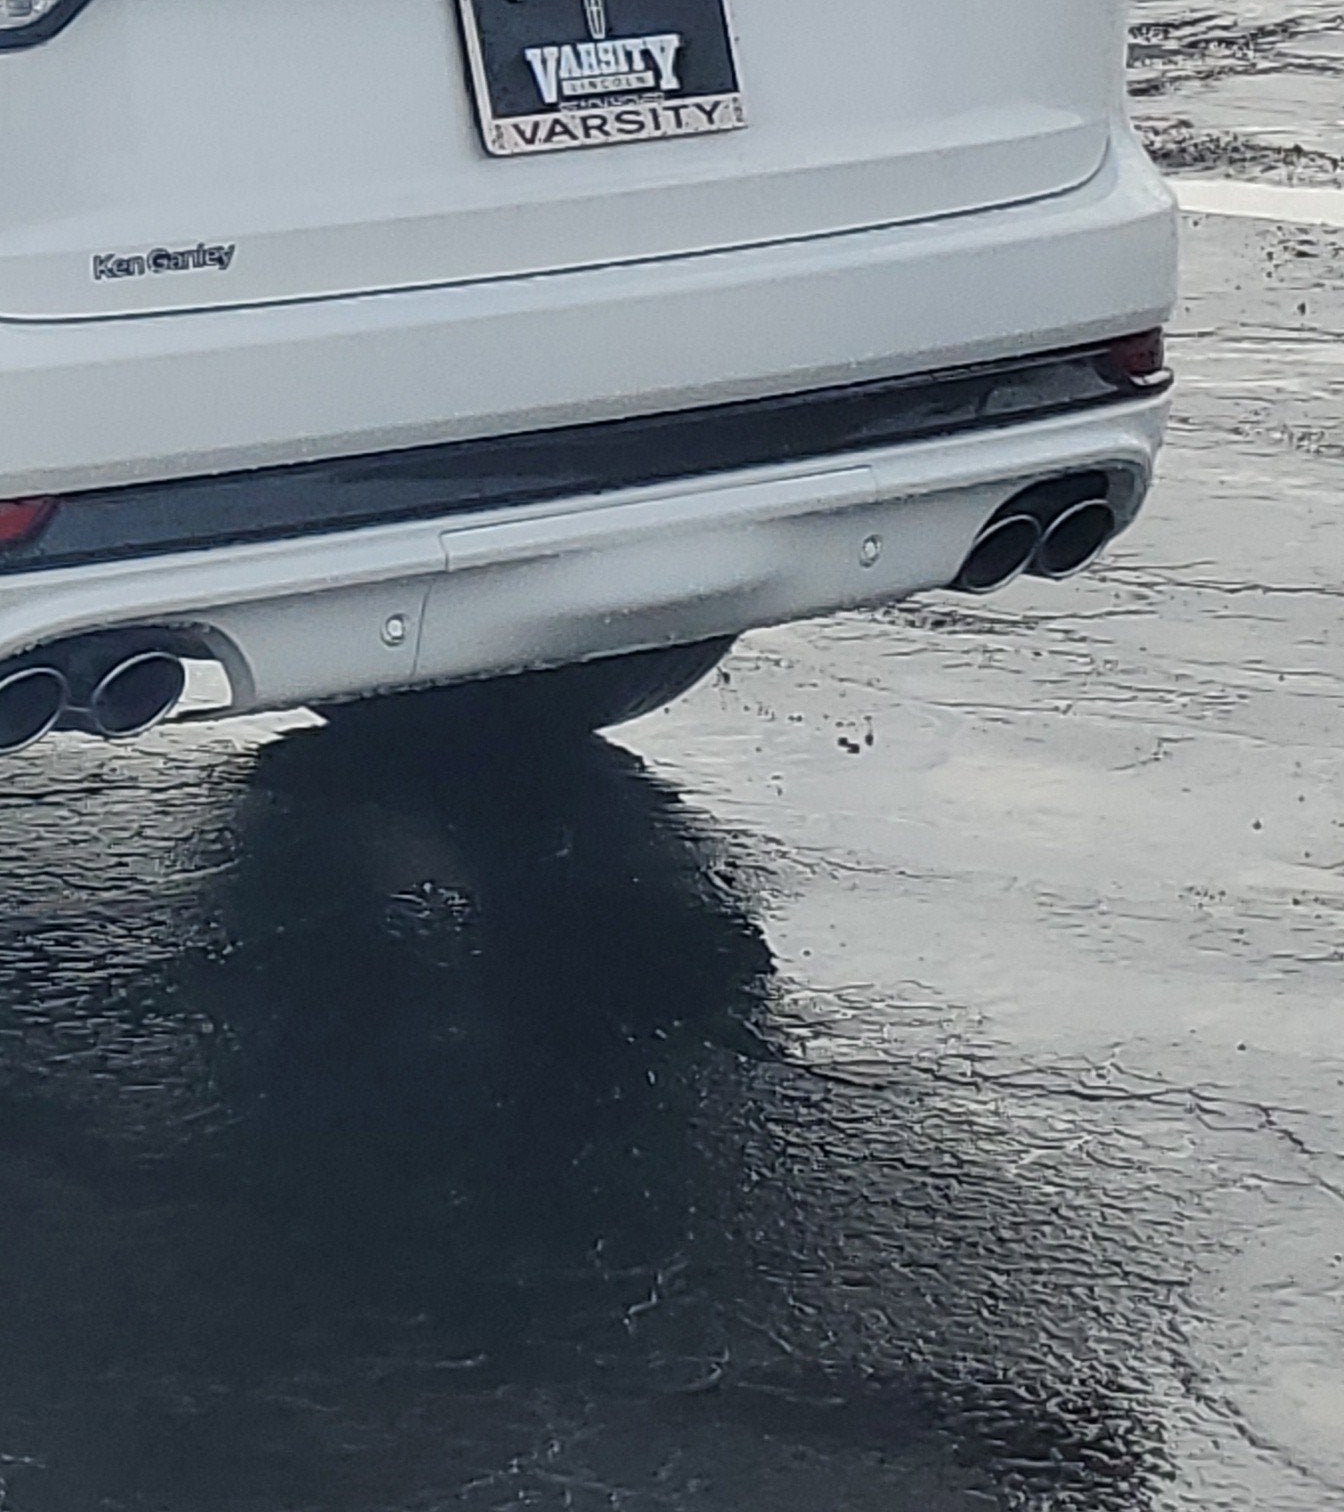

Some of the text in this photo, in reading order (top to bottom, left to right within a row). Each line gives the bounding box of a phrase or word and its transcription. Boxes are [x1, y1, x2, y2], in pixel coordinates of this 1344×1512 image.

[524, 34, 681, 104] VARSITY
[569, 76, 649, 93] LINCOLN
[512, 99, 722, 145] VARSITY
[93, 253, 146, 280] Ken
